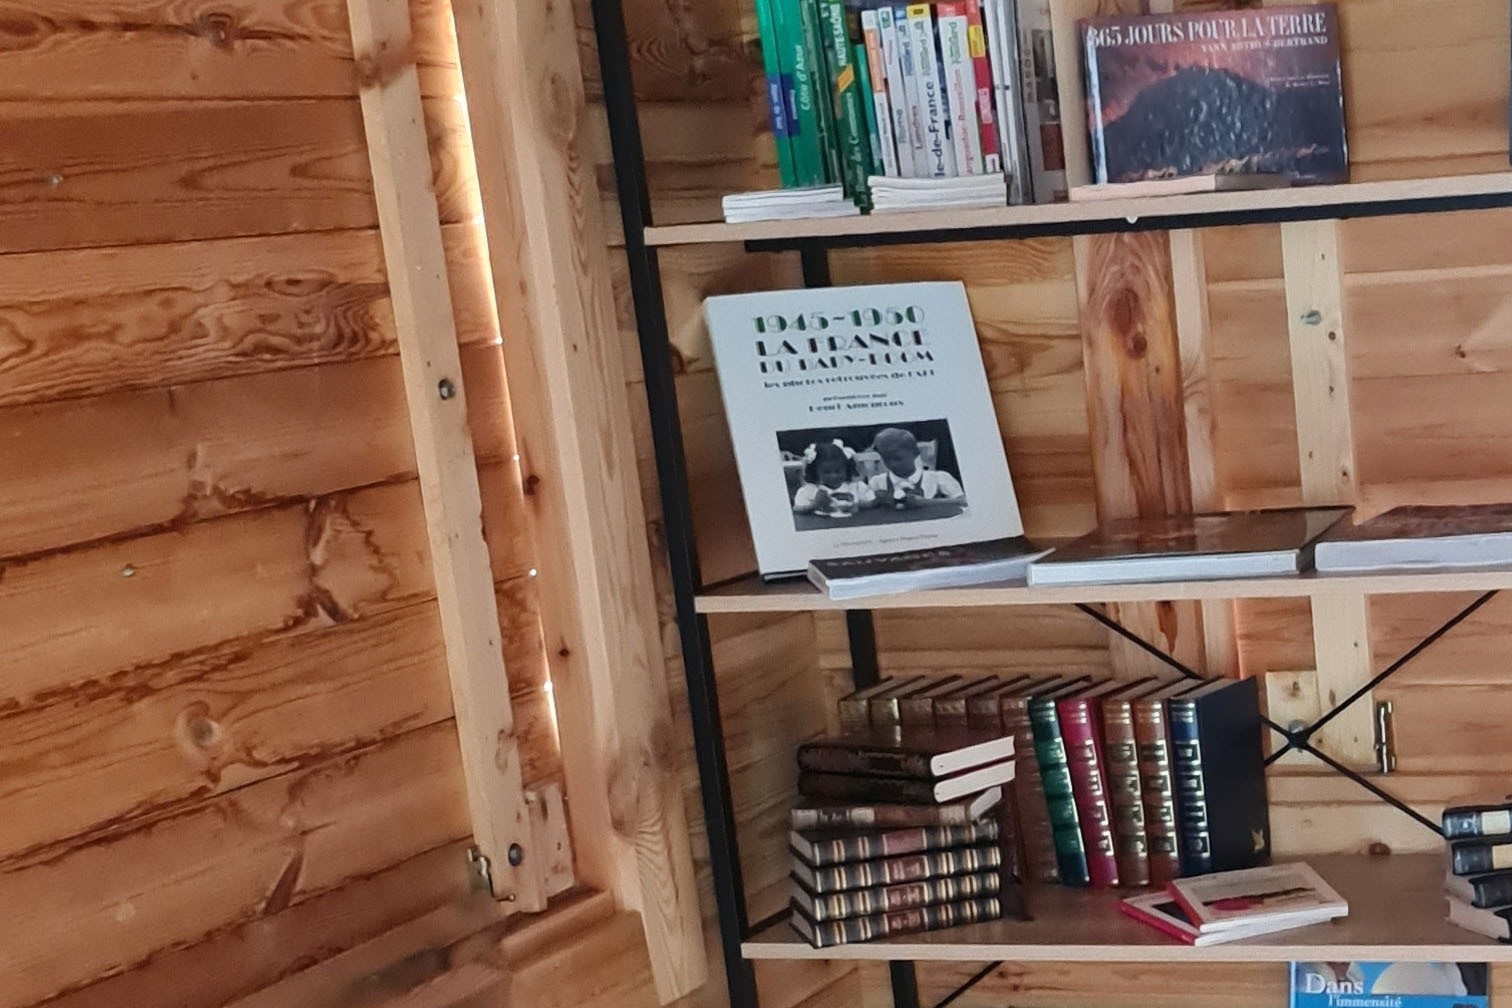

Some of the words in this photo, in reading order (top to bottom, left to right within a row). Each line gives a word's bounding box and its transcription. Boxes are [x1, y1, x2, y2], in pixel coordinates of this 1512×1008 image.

[1090, 24, 1121, 48] 365
[1125, 21, 1185, 45] JOURS
[1188, 17, 1240, 41] POUR
[1240, 16, 1265, 38] LA
[1266, 12, 1327, 36] TERRE
[926, 81, 946, 178] le-de-France
[755, 338, 798, 357] LA
[806, 329, 931, 354] FRANCE
[1304, 973, 1364, 996] Dans
[1328, 995, 1402, 1008] l'immensité
